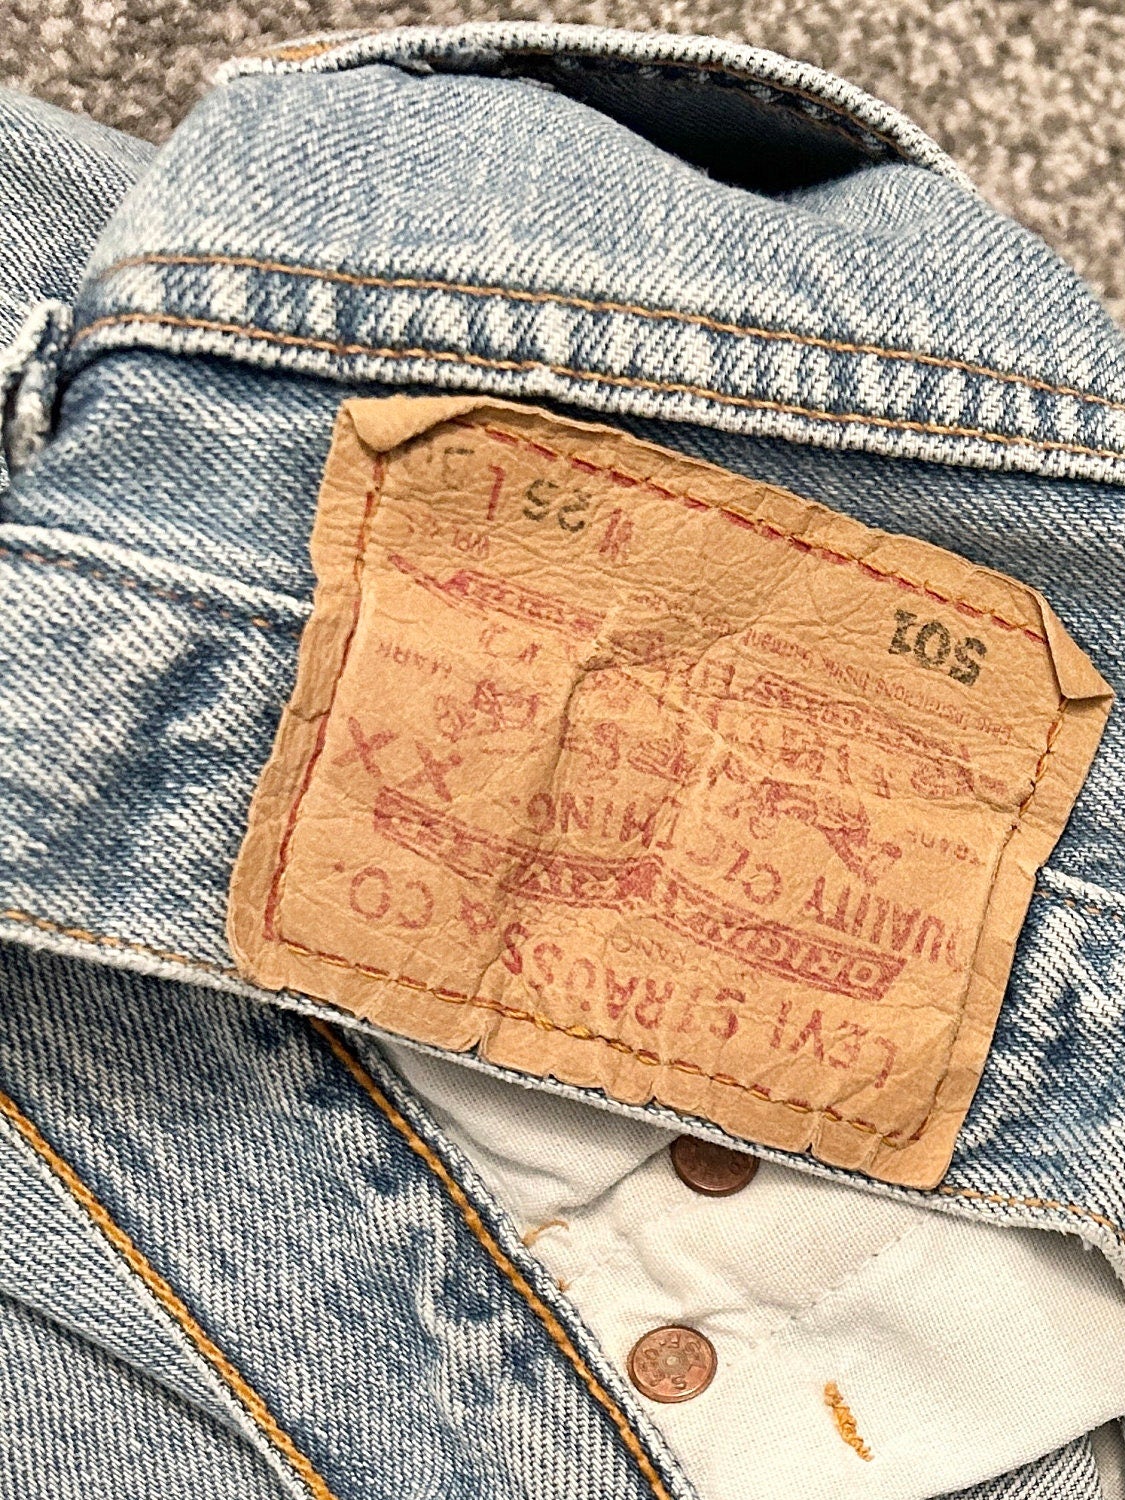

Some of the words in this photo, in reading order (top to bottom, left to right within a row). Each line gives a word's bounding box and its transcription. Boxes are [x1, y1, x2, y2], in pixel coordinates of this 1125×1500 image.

[886, 607, 987, 688] 501
[500, 921, 746, 1041] STRAUSS
[768, 999, 897, 1091] LEVI
